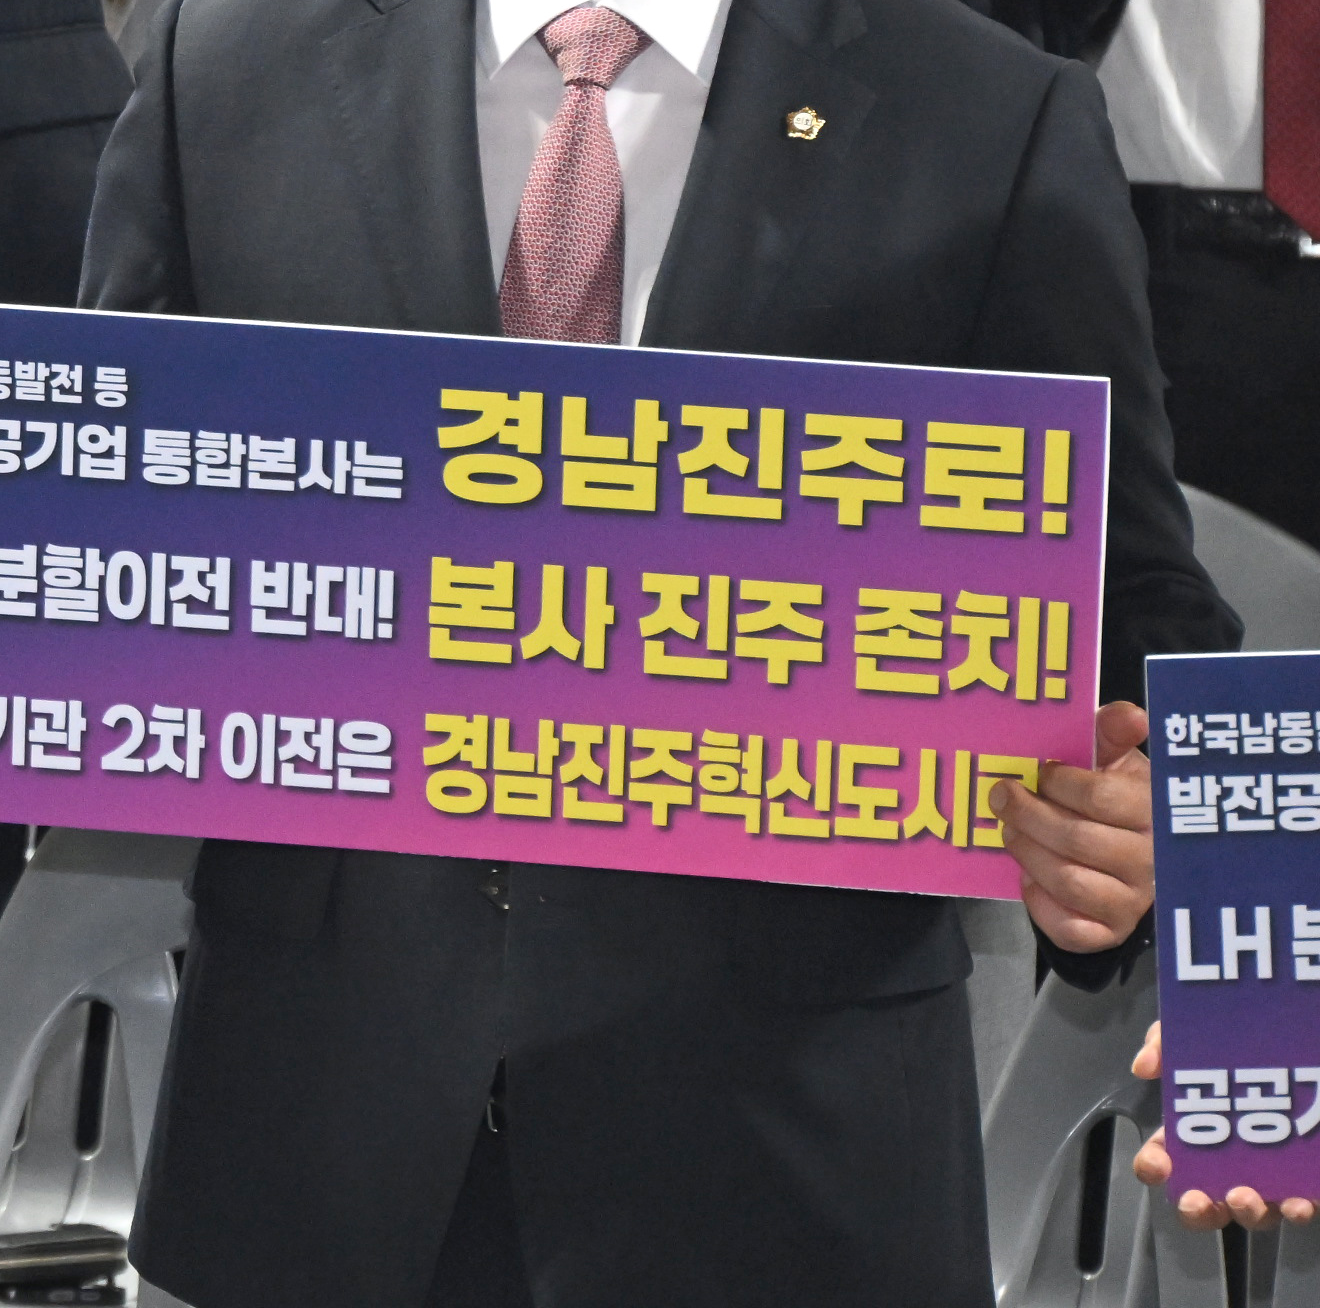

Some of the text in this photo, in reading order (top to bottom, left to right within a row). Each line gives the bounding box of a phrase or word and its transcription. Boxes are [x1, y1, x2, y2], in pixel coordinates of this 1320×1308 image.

[94, 367, 128, 407] 등
[143, 429, 403, 498] 통합본사는
[438, 389, 1070, 534] 경남진주로!
[250, 560, 394, 639] 반대!
[429, 557, 614, 669] 본사
[639, 573, 824, 684] 진주
[854, 588, 1069, 700] 존치!
[1165, 711, 1320, 756] 한국남동
[101, 704, 205, 778] 2차
[220, 712, 391, 793] 이전은
[421, 712, 1061, 848] 경남진주혁신도시로
[1168, 774, 1320, 833] 발전공
[1175, 907, 1272, 980] LH
